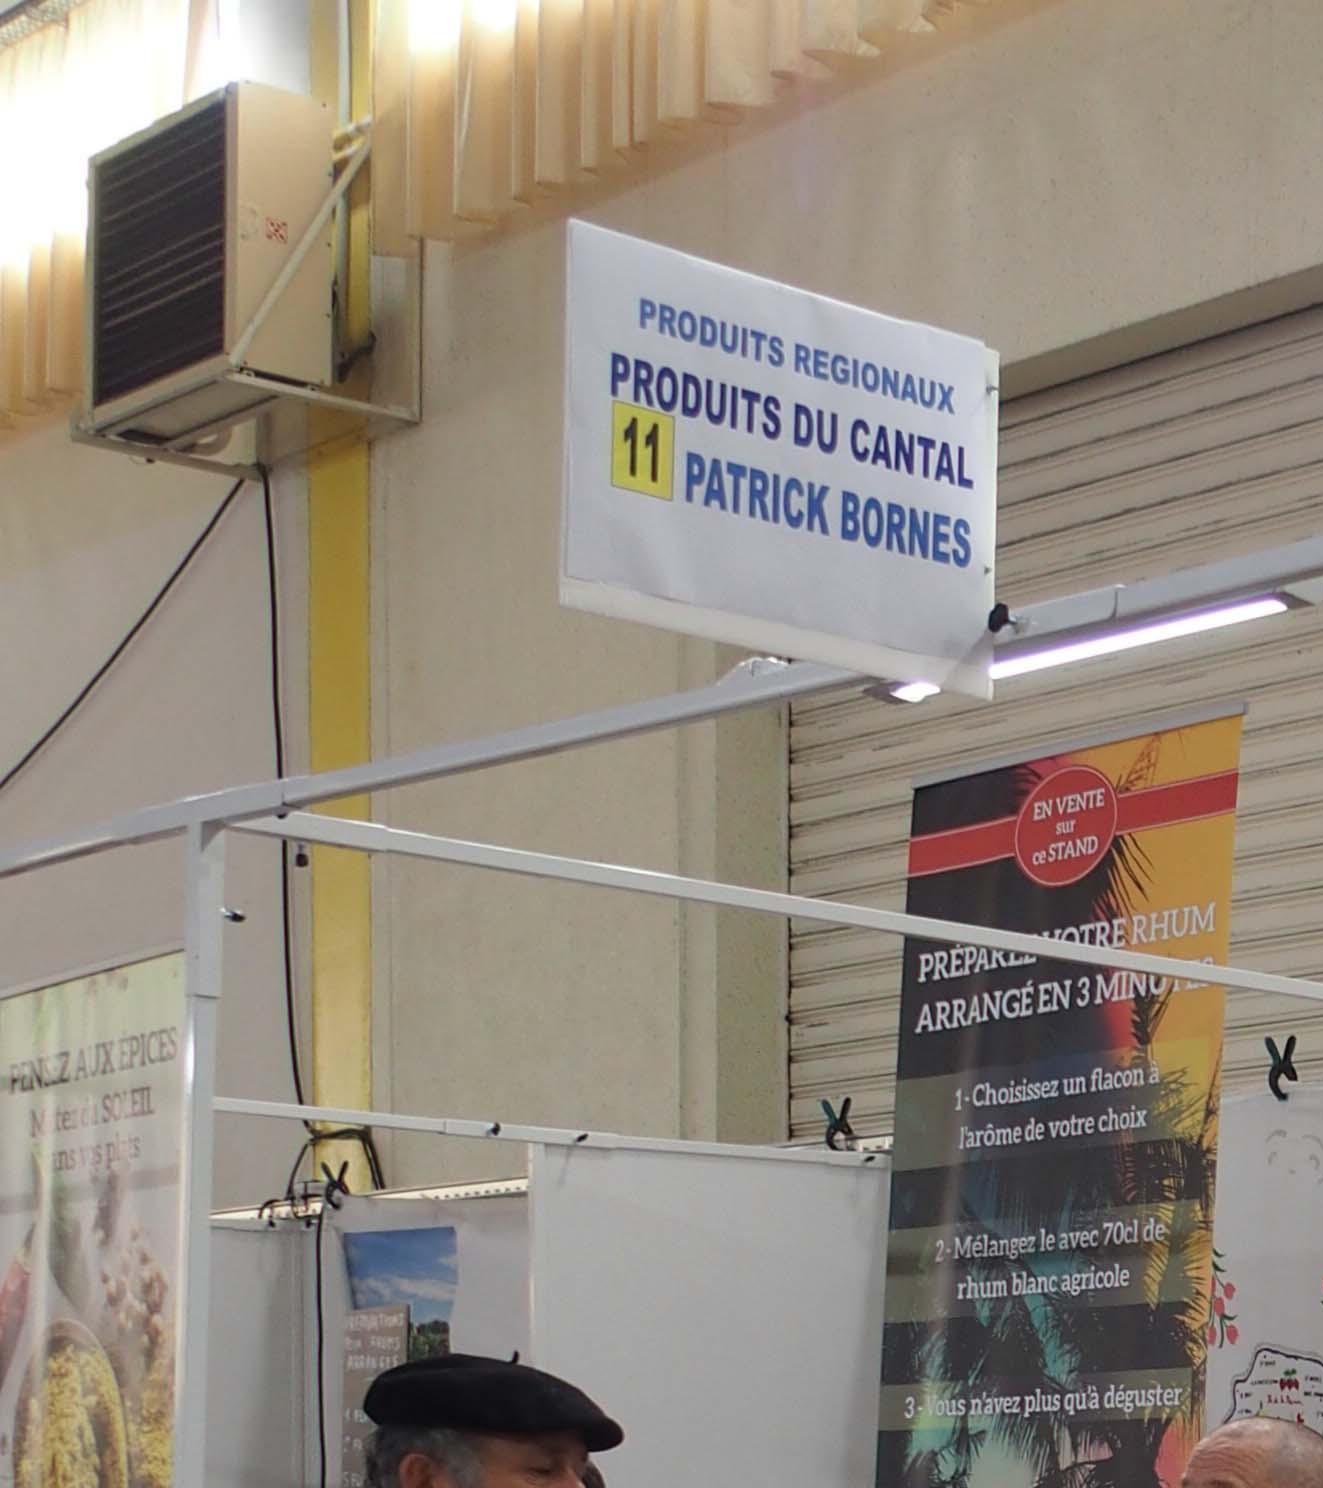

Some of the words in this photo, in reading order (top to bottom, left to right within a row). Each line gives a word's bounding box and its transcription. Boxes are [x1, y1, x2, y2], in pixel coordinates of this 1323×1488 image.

[640, 297, 785, 368] PRODUITS
[794, 343, 955, 415] REGIONAUX
[610, 352, 783, 441] PRODUITS
[794, 403, 840, 454] DU
[850, 418, 975, 490] CANTAL
[623, 416, 660, 483] 11
[685, 451, 831, 536] PATRICK
[841, 490, 972, 568] BORNES
[1032, 798, 1052, 822] EN
[1055, 788, 1106, 815] VENTE
[1056, 818, 1077, 834] sur
[1032, 850, 1047, 866] ce
[1047, 836, 1099, 861] STAND
[1131, 902, 1217, 946] RHUM
[914, 980, 1034, 1034] ARRANGÉ
[1037, 979, 1072, 1015] EN
[1077, 976, 1090, 1007] 3
[972, 1079, 1059, 1107] Choisissez
[1063, 1075, 1088, 1094] un
[1091, 1066, 1145, 1091] flacon
[1148, 1061, 1161, 1084] à
[1025, 1121, 1046, 1142] de
[1048, 1114, 1095, 1140] votre
[1098, 1106, 1149, 1132] choix
[952, 1229, 1036, 1261] Mélangez
[1040, 1227, 1056, 1251] le
[1058, 1228, 1099, 1250] avec
[1102, 1219, 1140, 1246] 70cl
[1143, 1218, 1167, 1242] de
[956, 1274, 1008, 1300] rhum
[1011, 1271, 1057, 1296] blanc
[1060, 1265, 1130, 1292] agricole
[1023, 1388, 1061, 1415] plus
[1104, 1384, 1184, 1412] déguster
